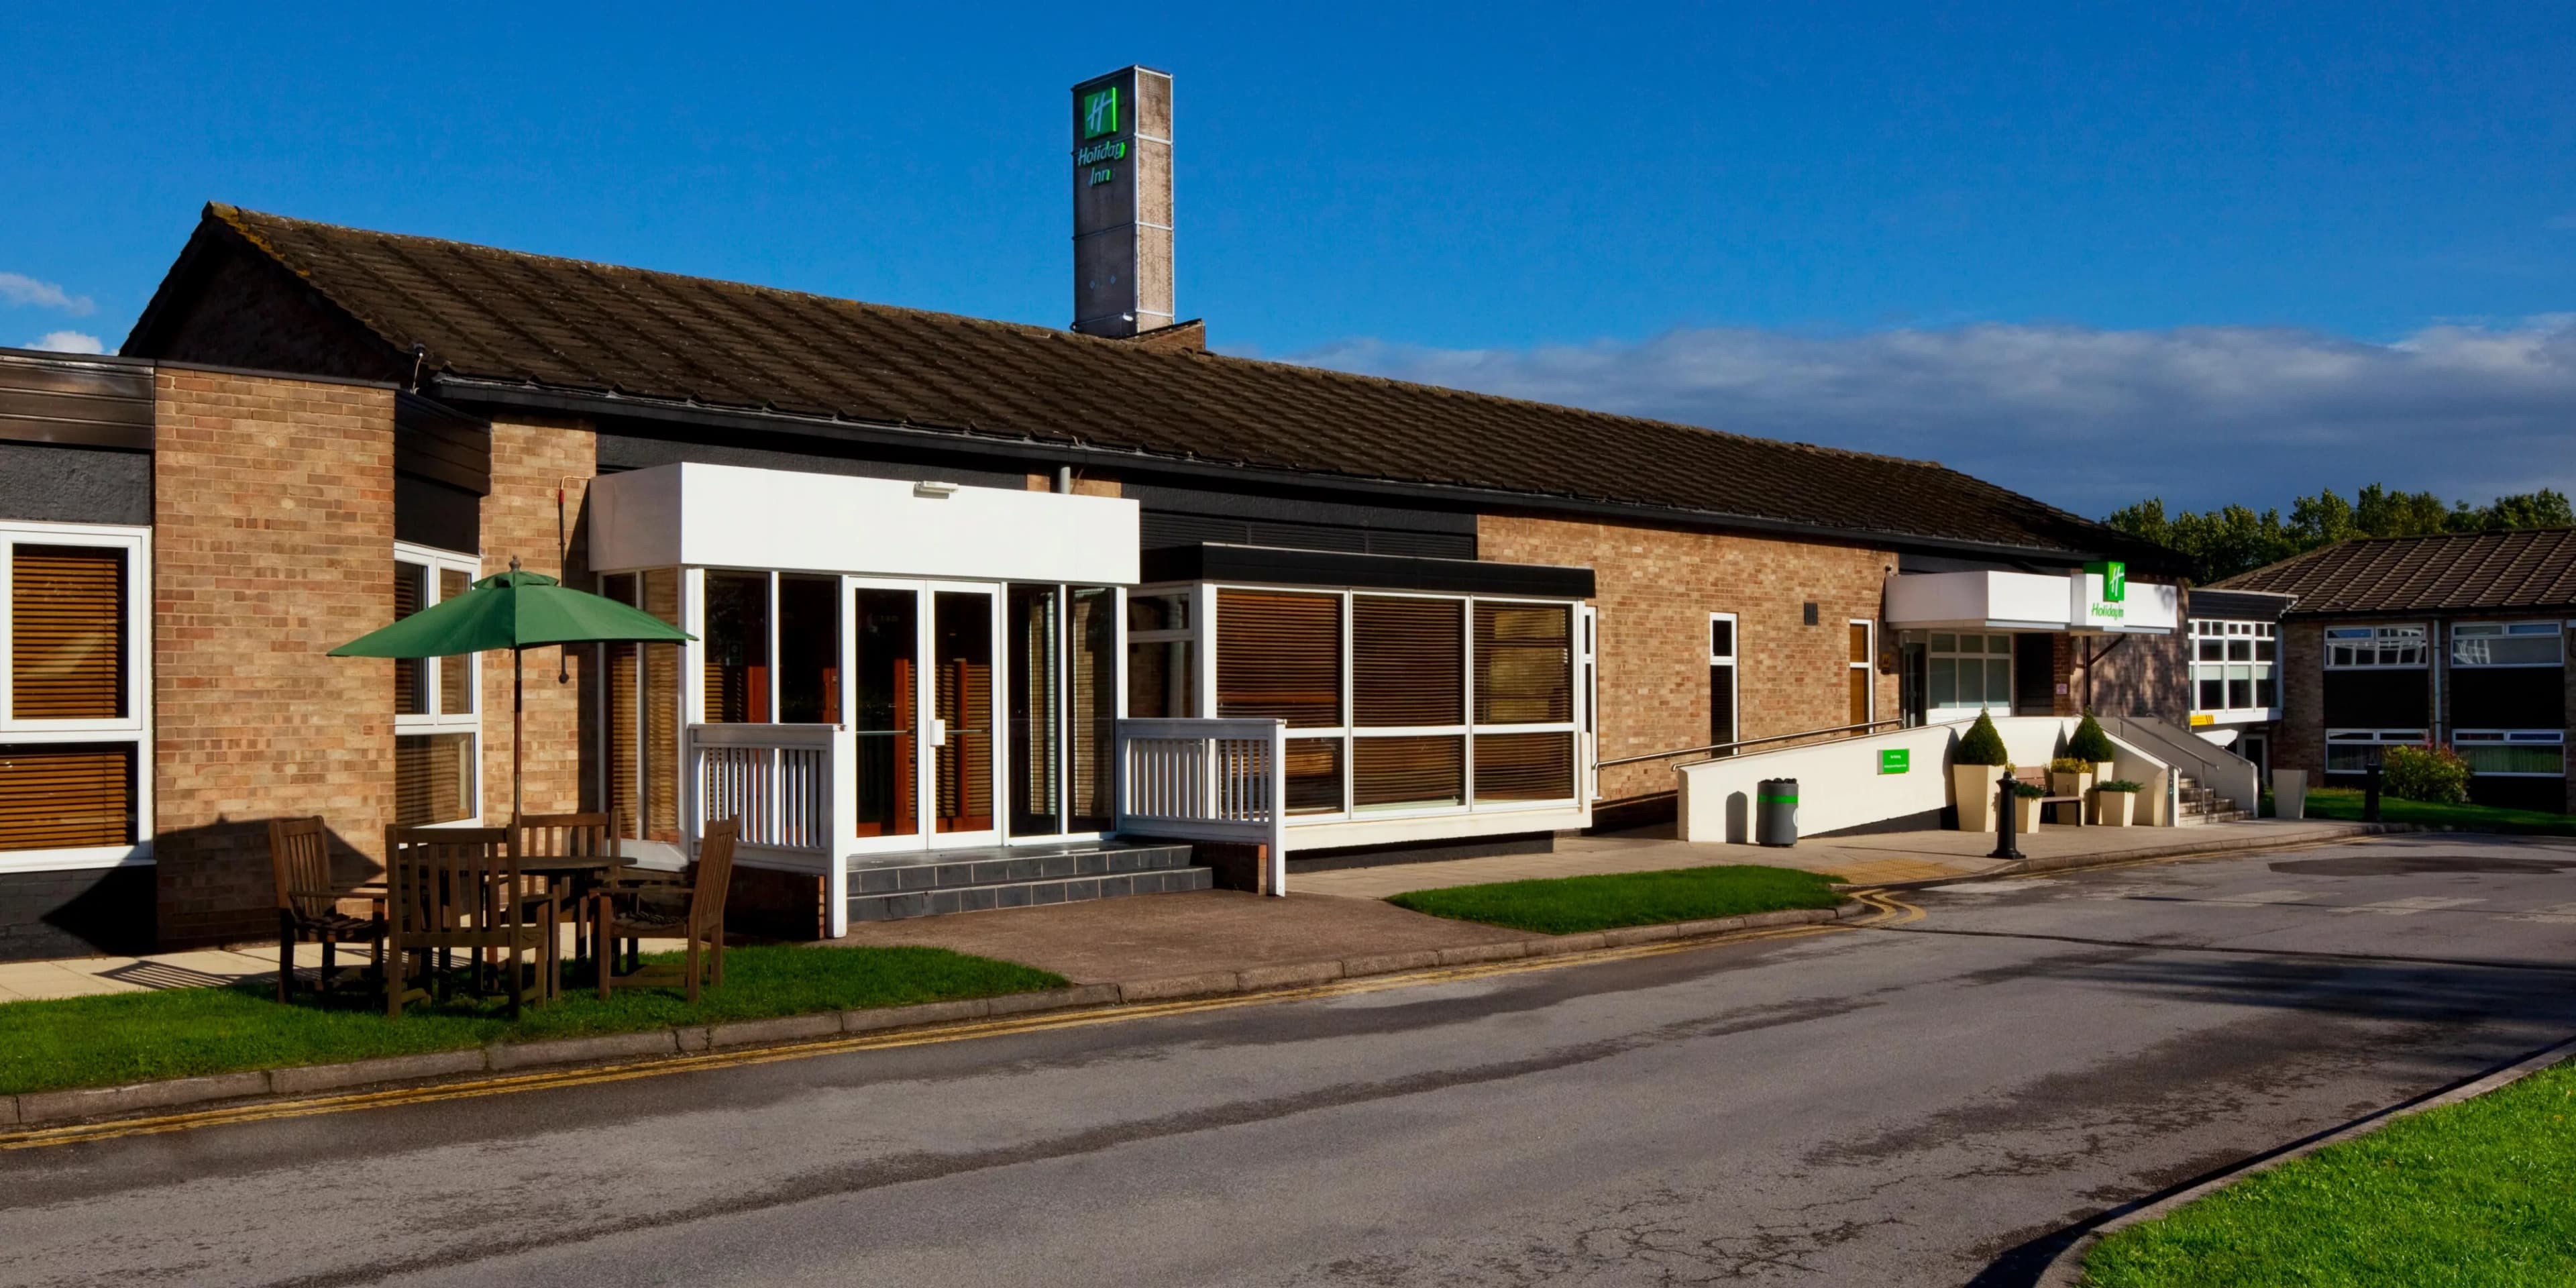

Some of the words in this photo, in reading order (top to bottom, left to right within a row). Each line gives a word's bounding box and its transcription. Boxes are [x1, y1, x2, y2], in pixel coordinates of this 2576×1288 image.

[1078, 140, 1126, 166] Holiday
[1089, 166, 1111, 186] Inn
[2091, 602, 2118, 621] Holiday
